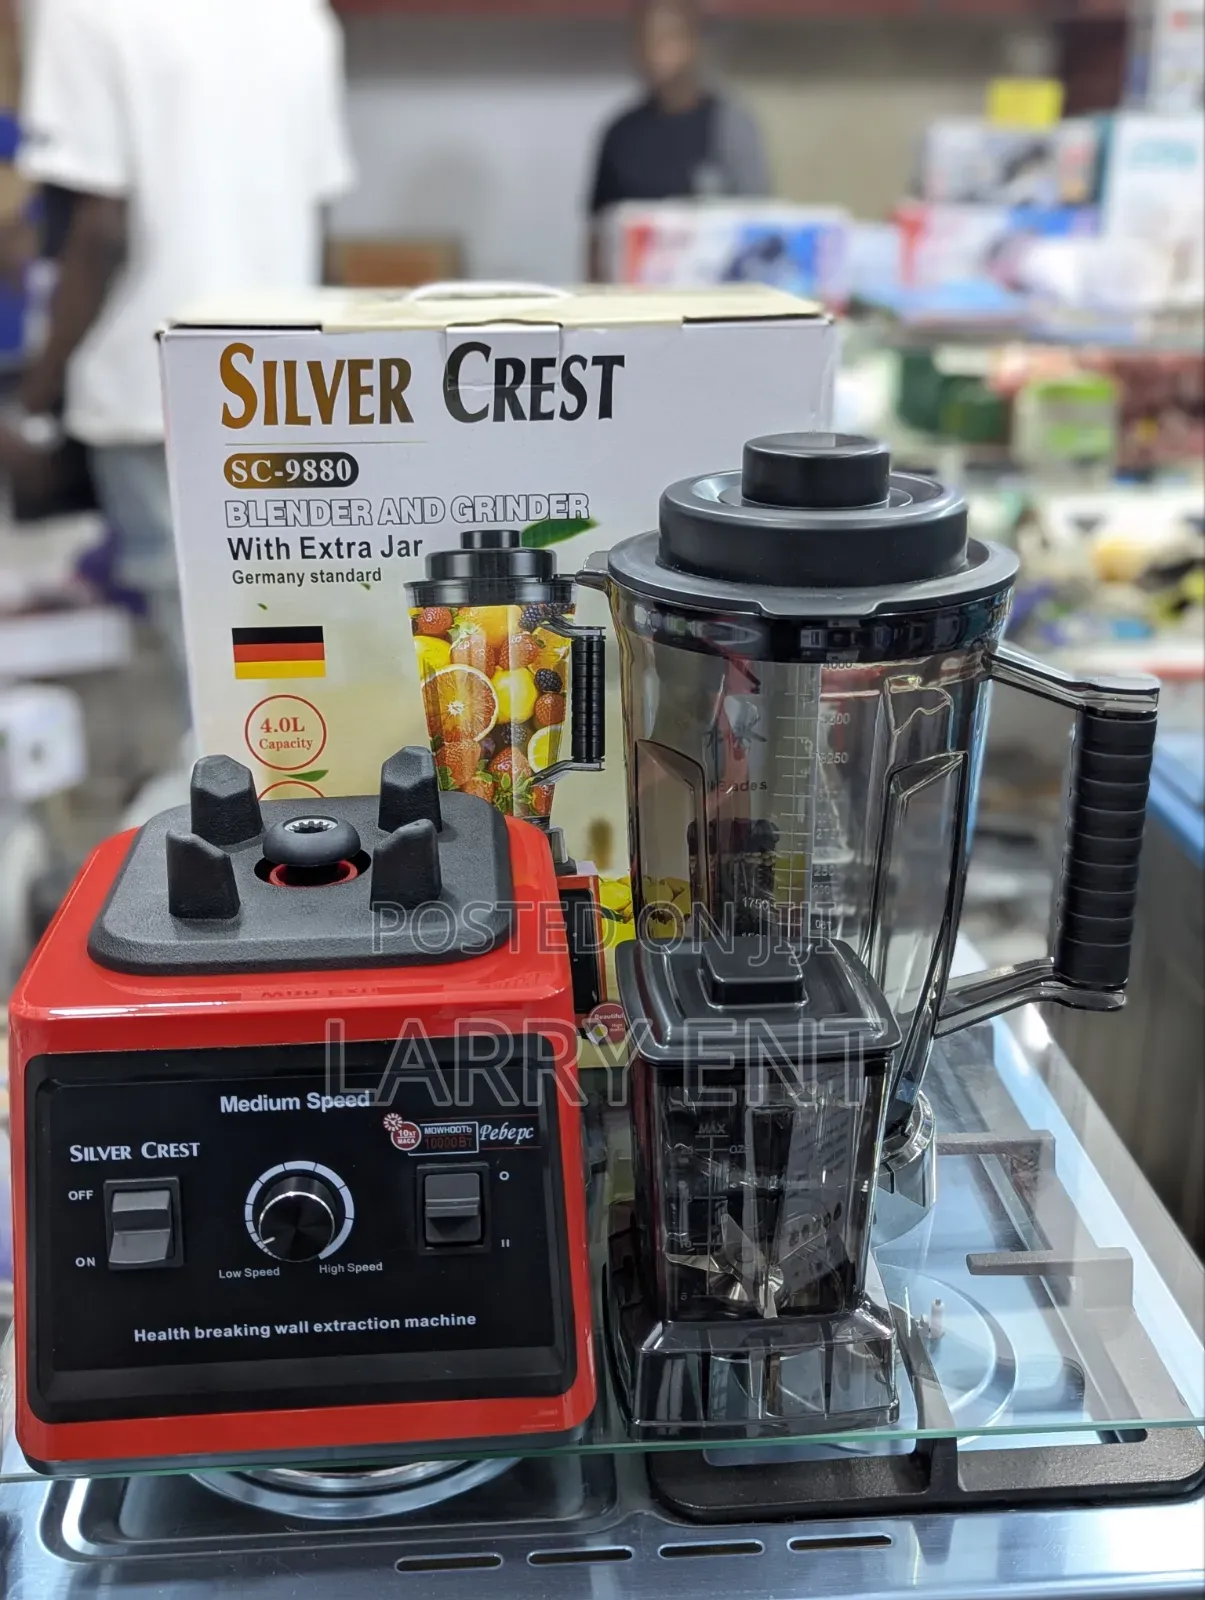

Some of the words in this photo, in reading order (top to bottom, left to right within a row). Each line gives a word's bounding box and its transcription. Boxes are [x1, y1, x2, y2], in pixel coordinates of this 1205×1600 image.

[231, 458, 352, 483] SC-9880
[225, 499, 373, 528] BLENDER
[378, 496, 446, 525] AND
[450, 493, 590, 523] GRINDER
[227, 536, 291, 560] With
[300, 536, 372, 559] Extra
[380, 534, 423, 558] Jar
[232, 569, 305, 587] Germany
[310, 567, 382, 584] standard
[260, 717, 305, 733] 4.0L
[259, 738, 313, 751] Capacity
[220, 1095, 300, 1113] Medium
[306, 1090, 370, 1112] Speed
[68, 1190, 94, 1201] OFF
[75, 1257, 96, 1267] ON
[319, 1263, 345, 1277] High
[347, 1261, 383, 1275] Speed
[218, 1269, 241, 1279] Low
[244, 1267, 280, 1280] Speed
[134, 1328, 190, 1342] Health
[194, 1322, 271, 1340] breaking
[275, 1320, 309, 1334] wall
[313, 1316, 400, 1333] extraction
[404, 1313, 476, 1328] machine
